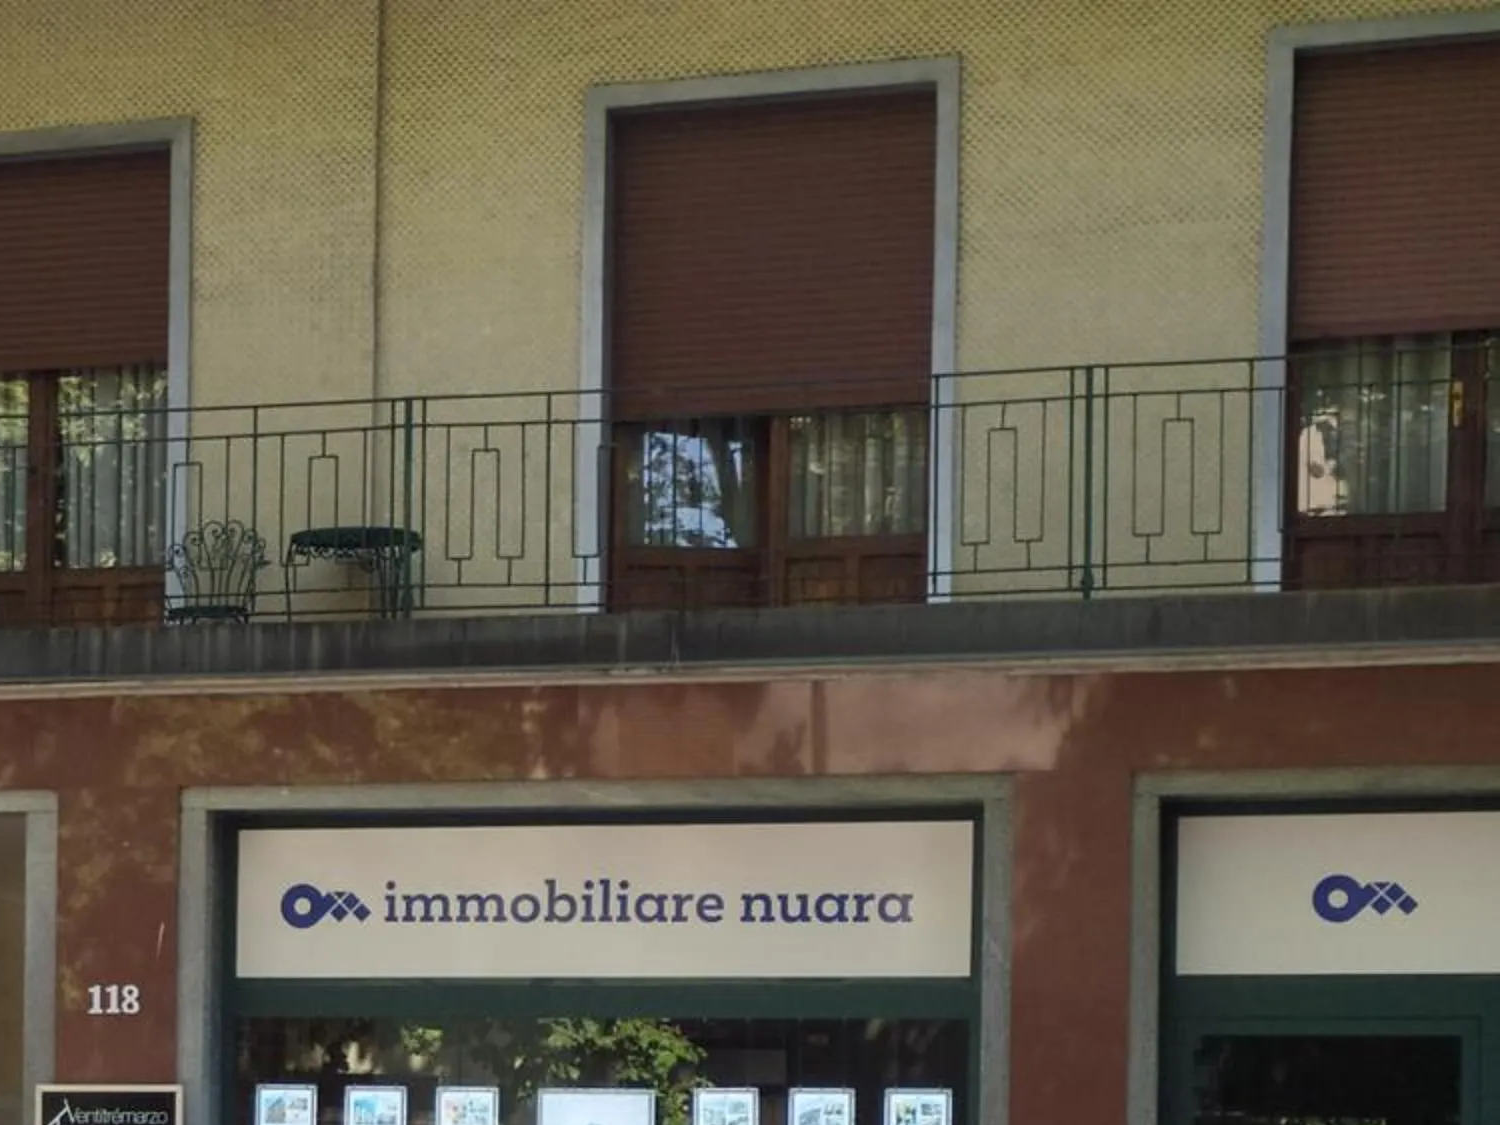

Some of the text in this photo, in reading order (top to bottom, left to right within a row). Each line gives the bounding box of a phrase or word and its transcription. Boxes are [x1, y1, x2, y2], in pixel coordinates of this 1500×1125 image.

[383, 878, 914, 926] immobiliare nuara
[87, 984, 141, 1015] 118
